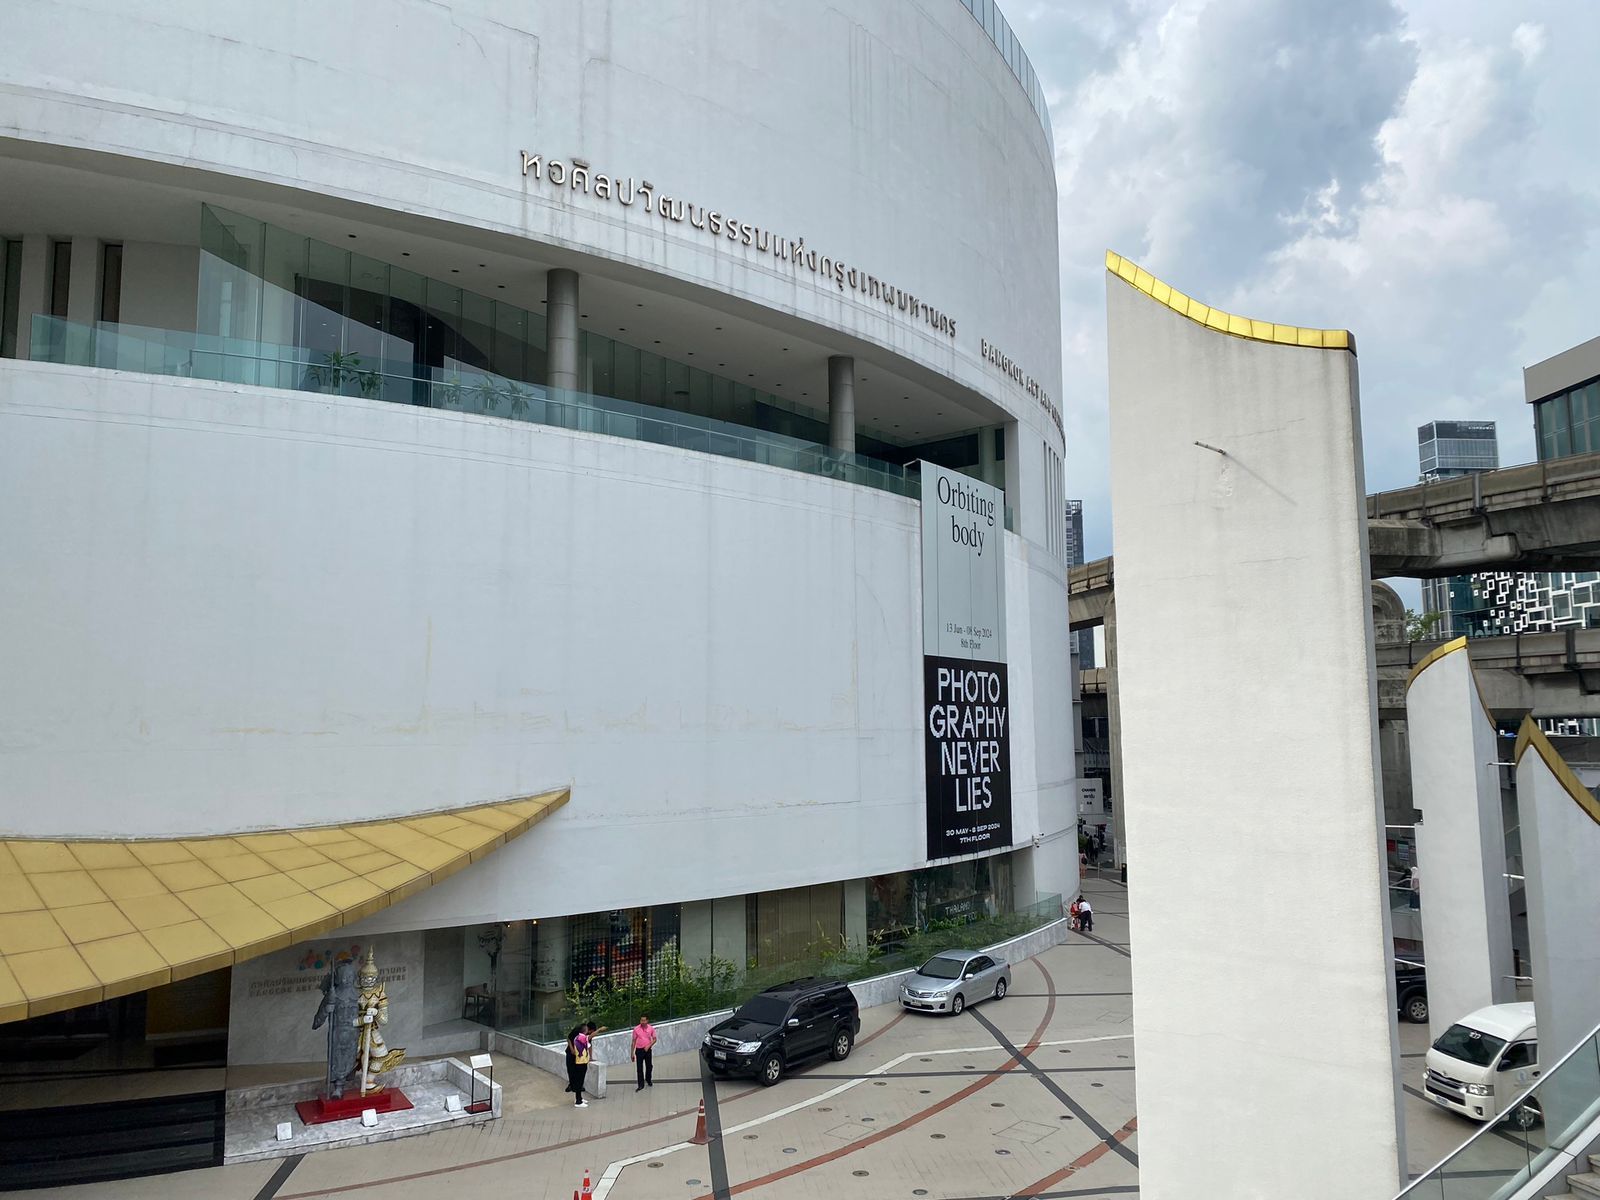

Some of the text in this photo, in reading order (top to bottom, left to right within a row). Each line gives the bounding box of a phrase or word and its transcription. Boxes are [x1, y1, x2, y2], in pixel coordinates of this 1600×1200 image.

[981, 338, 1024, 387] BANGKOK
[937, 476, 994, 527] Orbiting
[951, 515, 985, 557] body
[938, 667, 1001, 703] PHOTO
[929, 704, 1006, 738] GRAPHY
[941, 740, 1001, 776] NEVER
[955, 775, 992, 812] LIES
[945, 829, 955, 837] 30
[955, 827, 968, 835] MAY
[976, 824, 987, 833] SEP
[988, 822, 1001, 831] 2024
[960, 832, 991, 844] 7TH FLOOR
